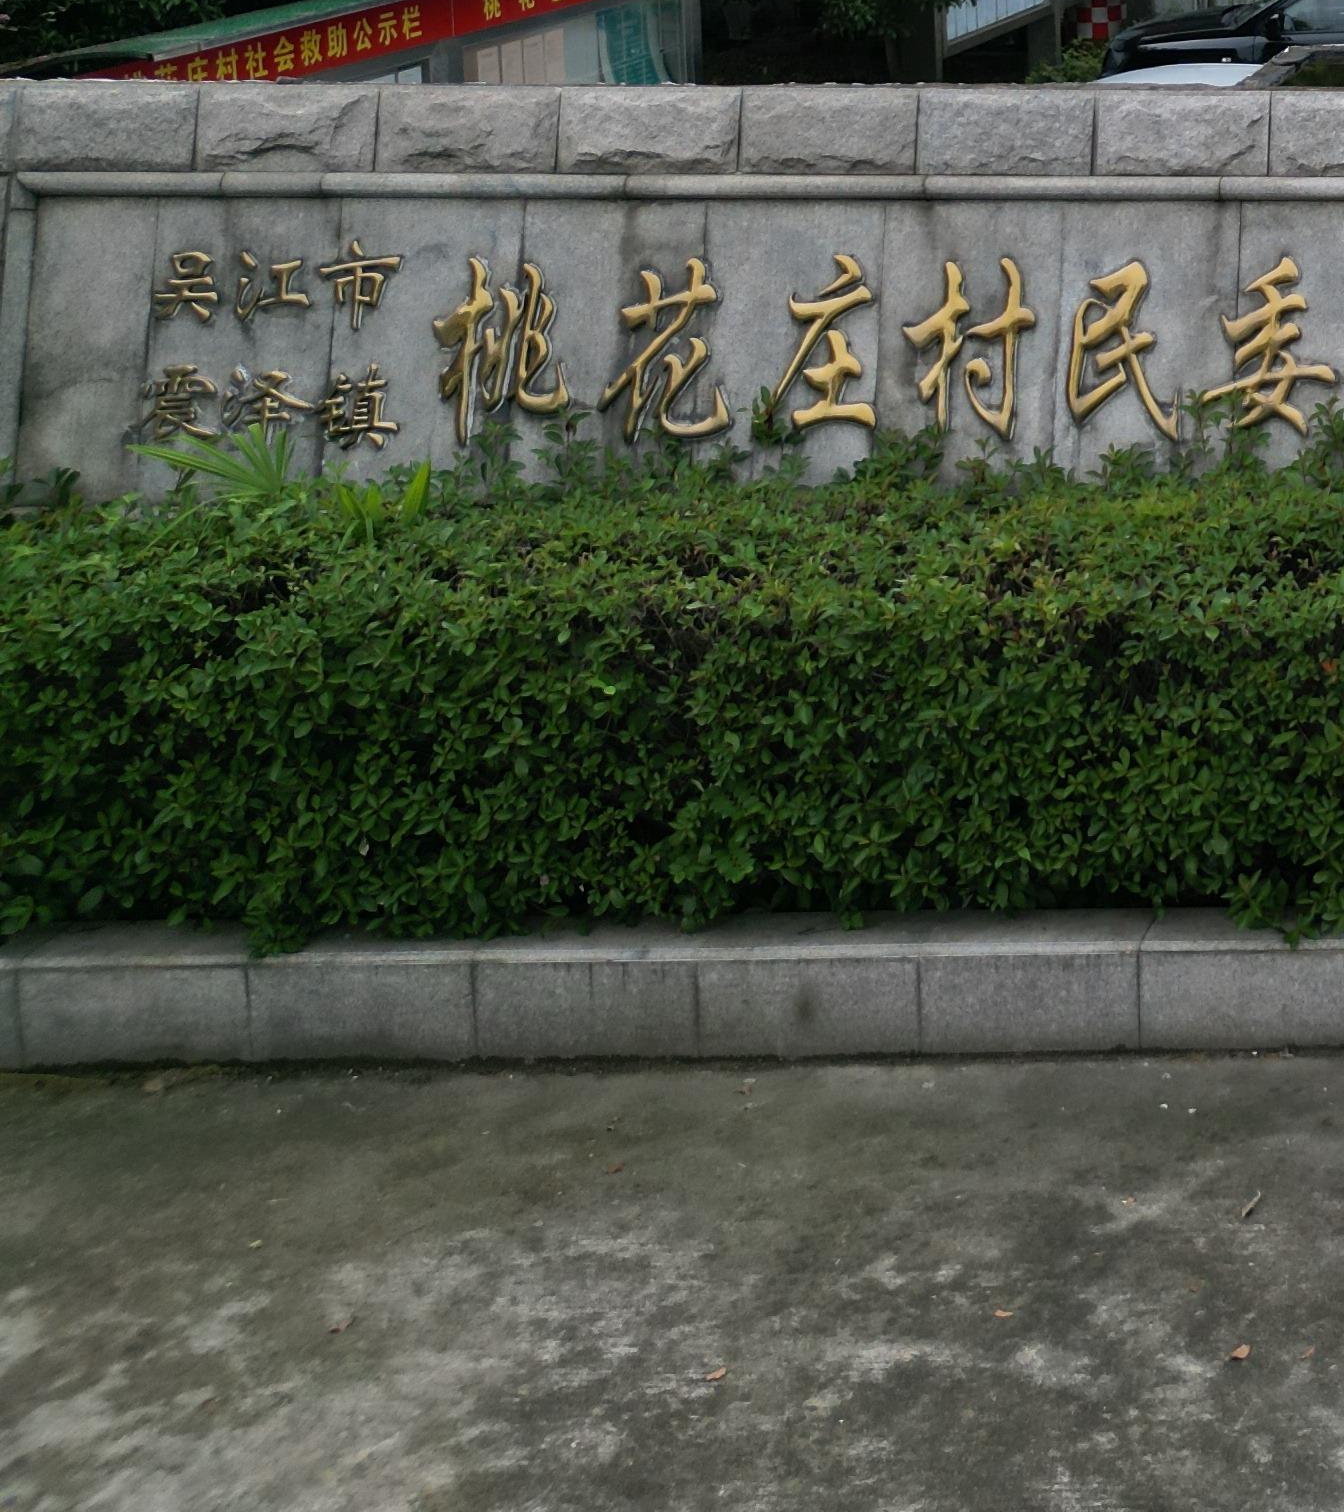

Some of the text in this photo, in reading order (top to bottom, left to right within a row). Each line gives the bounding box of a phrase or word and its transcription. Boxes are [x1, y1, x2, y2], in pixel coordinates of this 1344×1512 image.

[153, 239, 403, 331] 吴江市
[132, 361, 400, 451] 震泽镇
